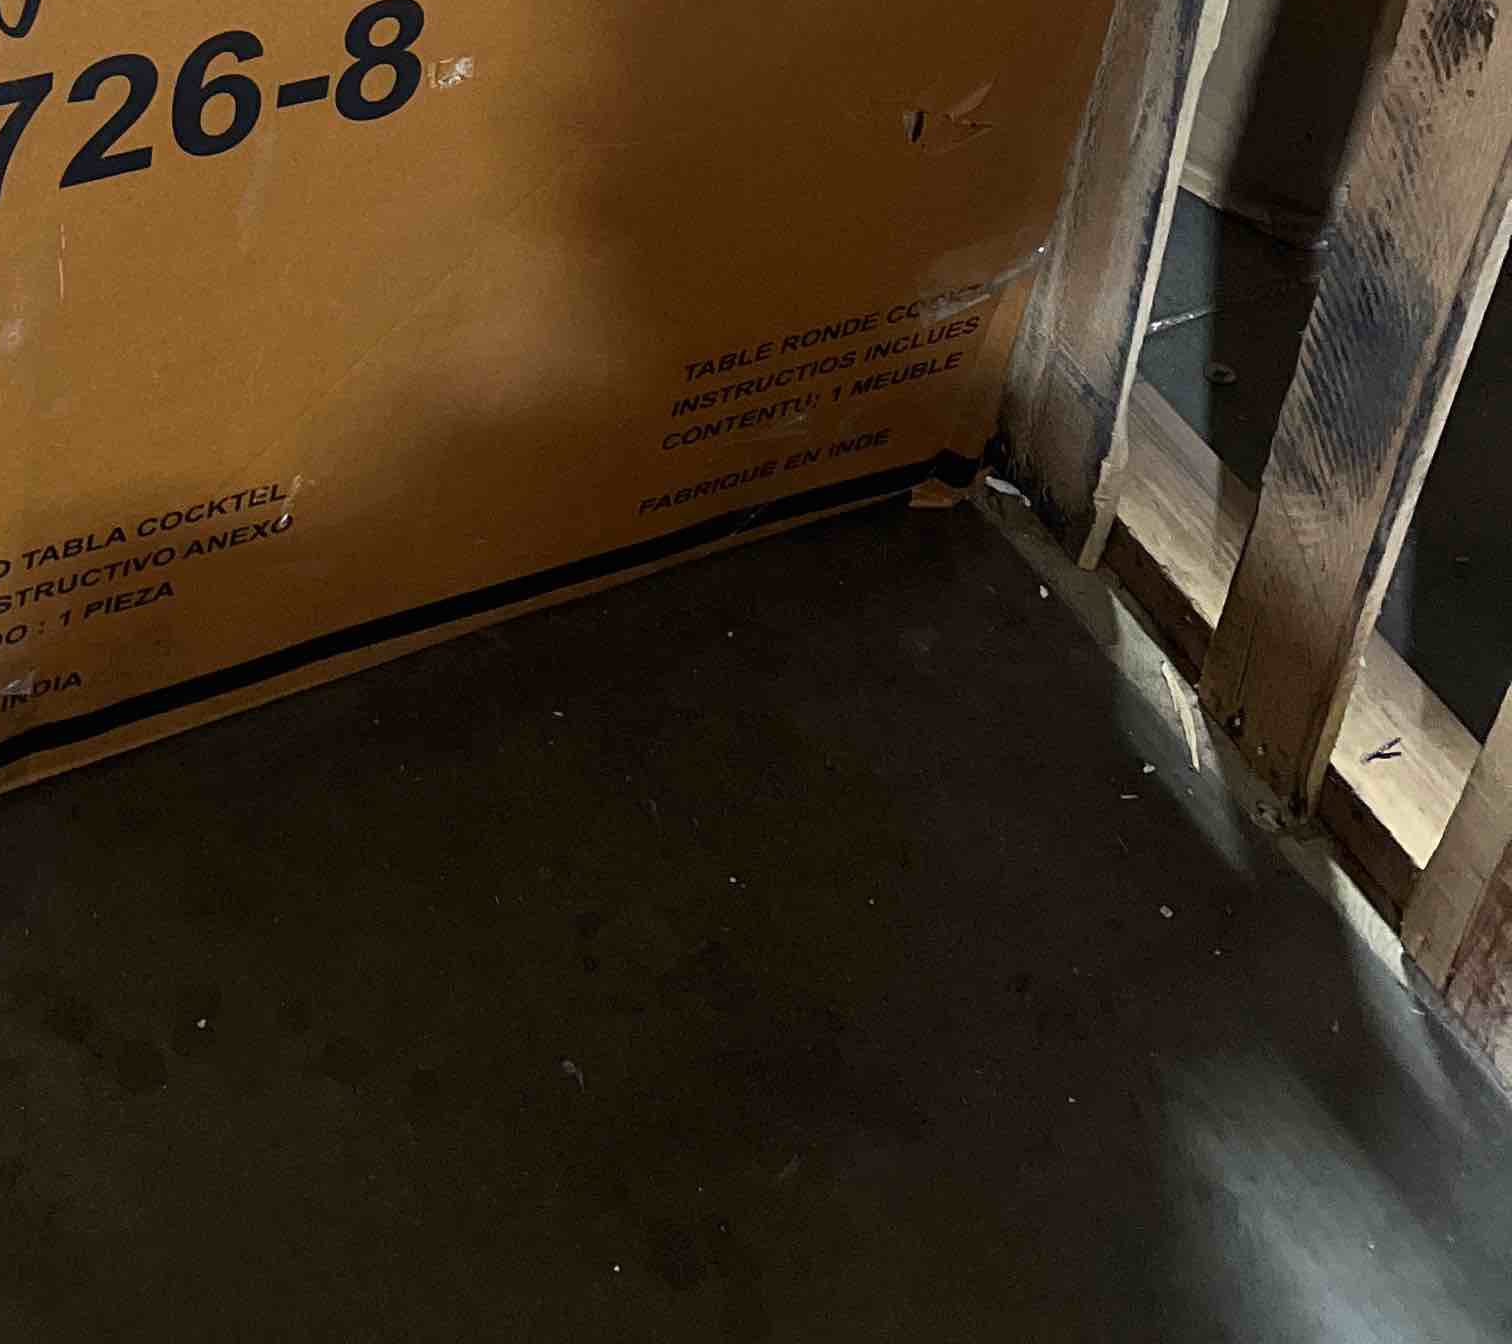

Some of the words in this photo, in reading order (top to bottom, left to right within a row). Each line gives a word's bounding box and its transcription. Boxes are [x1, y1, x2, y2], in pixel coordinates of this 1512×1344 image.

[685, 340, 774, 383] TABLE
[781, 311, 881, 355] RONDE
[864, 315, 981, 363] INCLUES
[832, 385, 843, 404] 1
[849, 351, 964, 397] MEUBLE
[638, 461, 778, 515] FABRIQUE
[784, 445, 823, 471] EN
[828, 428, 892, 459] INDE
[22, 526, 127, 570] TABLA
[137, 483, 288, 539] COCKTEL
[182, 515, 295, 561] ANEXO
[61, 610, 73, 629] 1
[83, 581, 176, 620] PIEZA
[1, 671, 83, 710] INDIA
